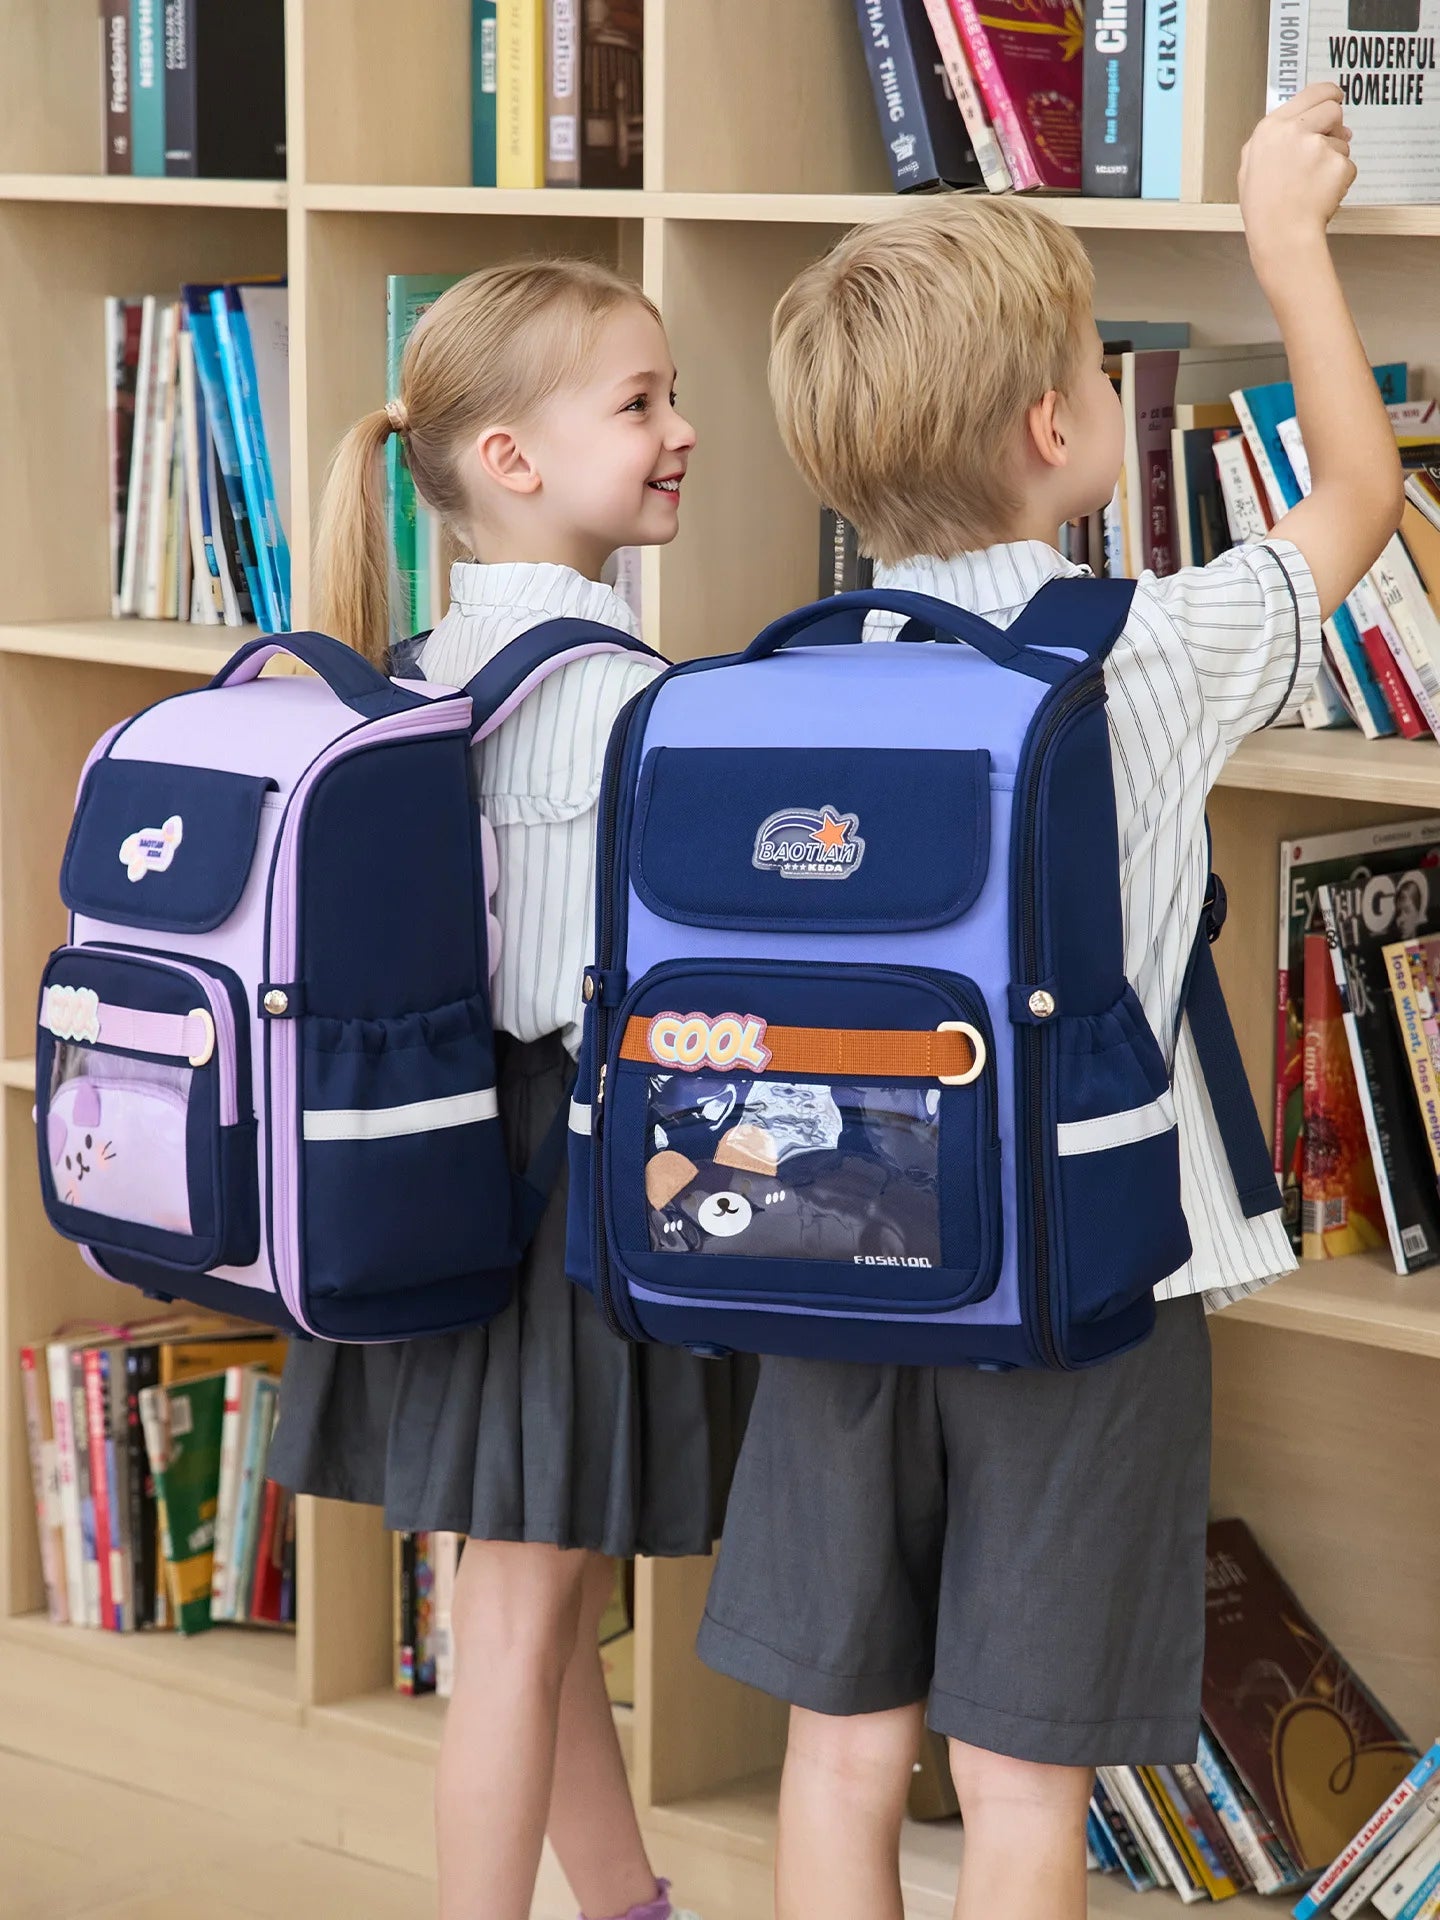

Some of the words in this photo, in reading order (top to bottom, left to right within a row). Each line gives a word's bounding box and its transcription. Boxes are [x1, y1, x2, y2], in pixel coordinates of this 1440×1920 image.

[865, 0, 890, 49] THAT
[879, 56, 905, 123] THING
[1329, 36, 1436, 69] WONDERFUL
[1339, 73, 1424, 105] HOMELIFE
[1104, 119, 1118, 144] Dan
[758, 841, 856, 864] BAOTIAN
[807, 863, 843, 872] KEDA
[1362, 869, 1429, 936] GQ
[1391, 954, 1407, 989] lose
[1402, 996, 1422, 1053] wheat,
[1416, 1057, 1431, 1094] lose
[651, 1017, 767, 1068] COOL
